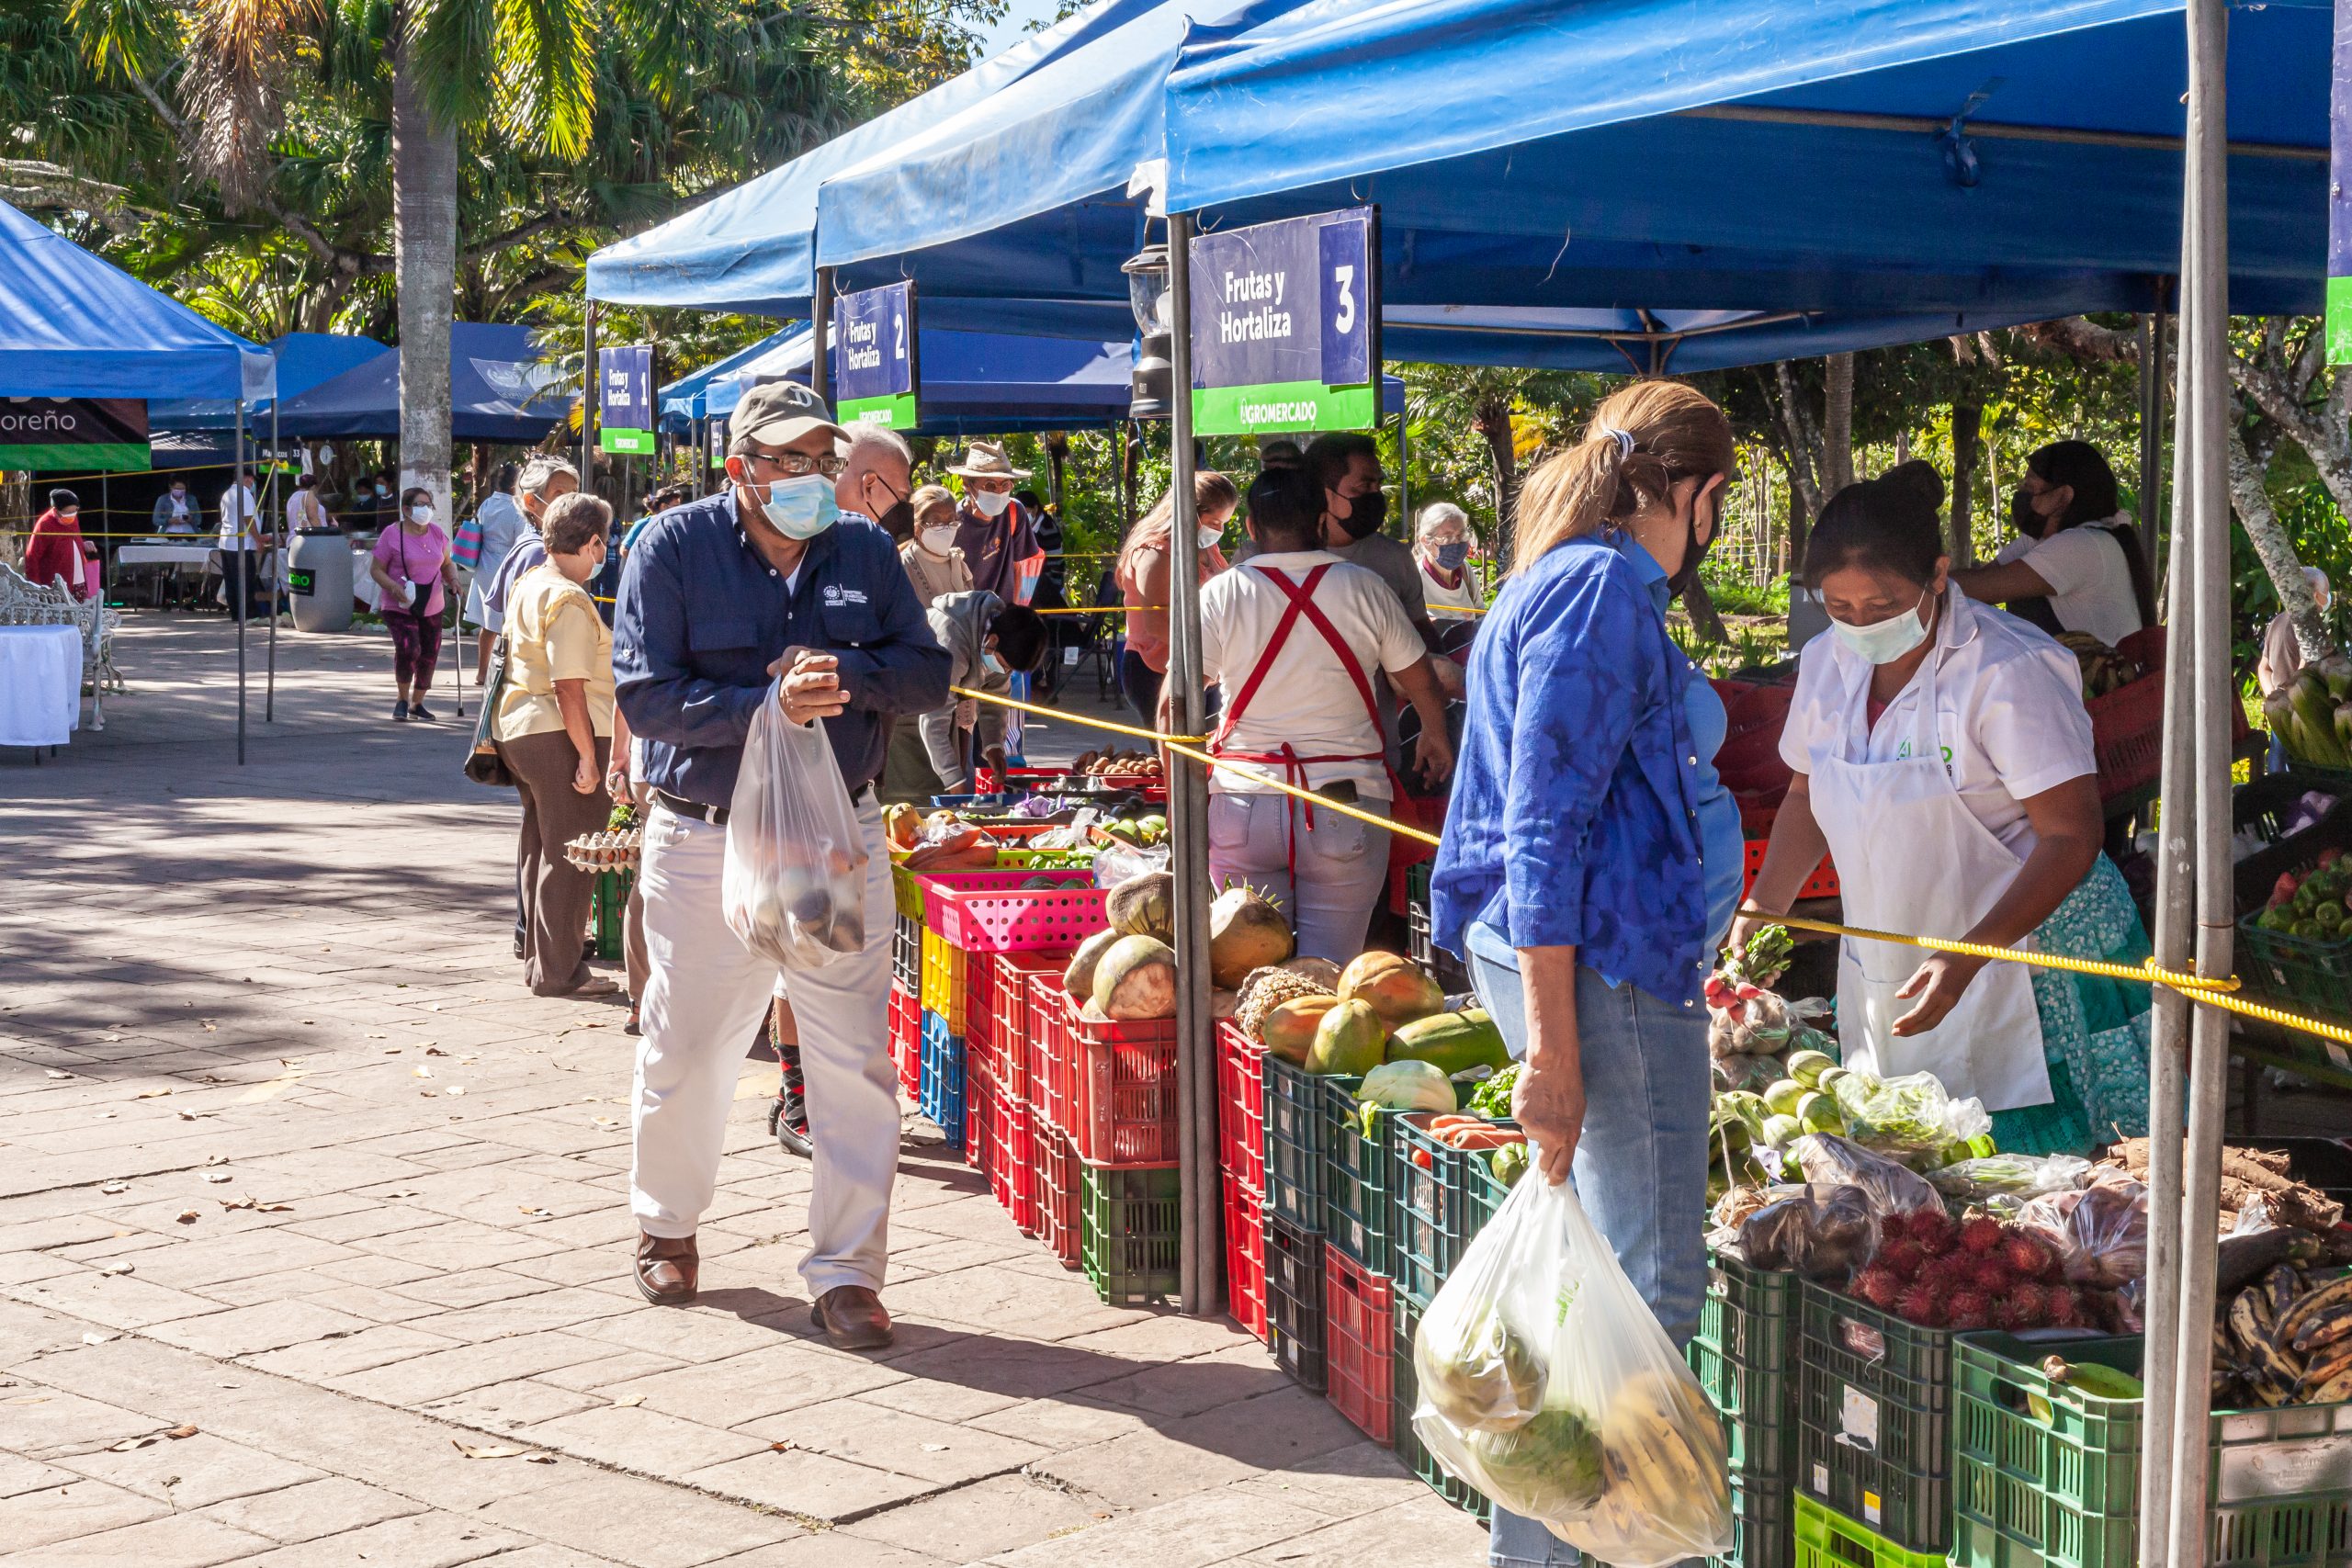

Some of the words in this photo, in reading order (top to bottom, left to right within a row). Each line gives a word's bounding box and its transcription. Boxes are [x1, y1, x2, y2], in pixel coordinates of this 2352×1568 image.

[1226, 270, 1272, 304] Frutas
[1274, 271, 1285, 306] y
[1335, 265, 1355, 334] 3
[850, 321, 871, 344] Frutas
[871, 321, 876, 344] y
[894, 313, 905, 360] 2
[1221, 306, 1292, 344] Hortaliza
[848, 345, 881, 370] Hortaliza
[608, 368, 625, 386] Frutas
[640, 371, 648, 406] 1
[607, 389, 630, 406] Hortaliza
[1240, 398, 1317, 424] AGROMERCADO
